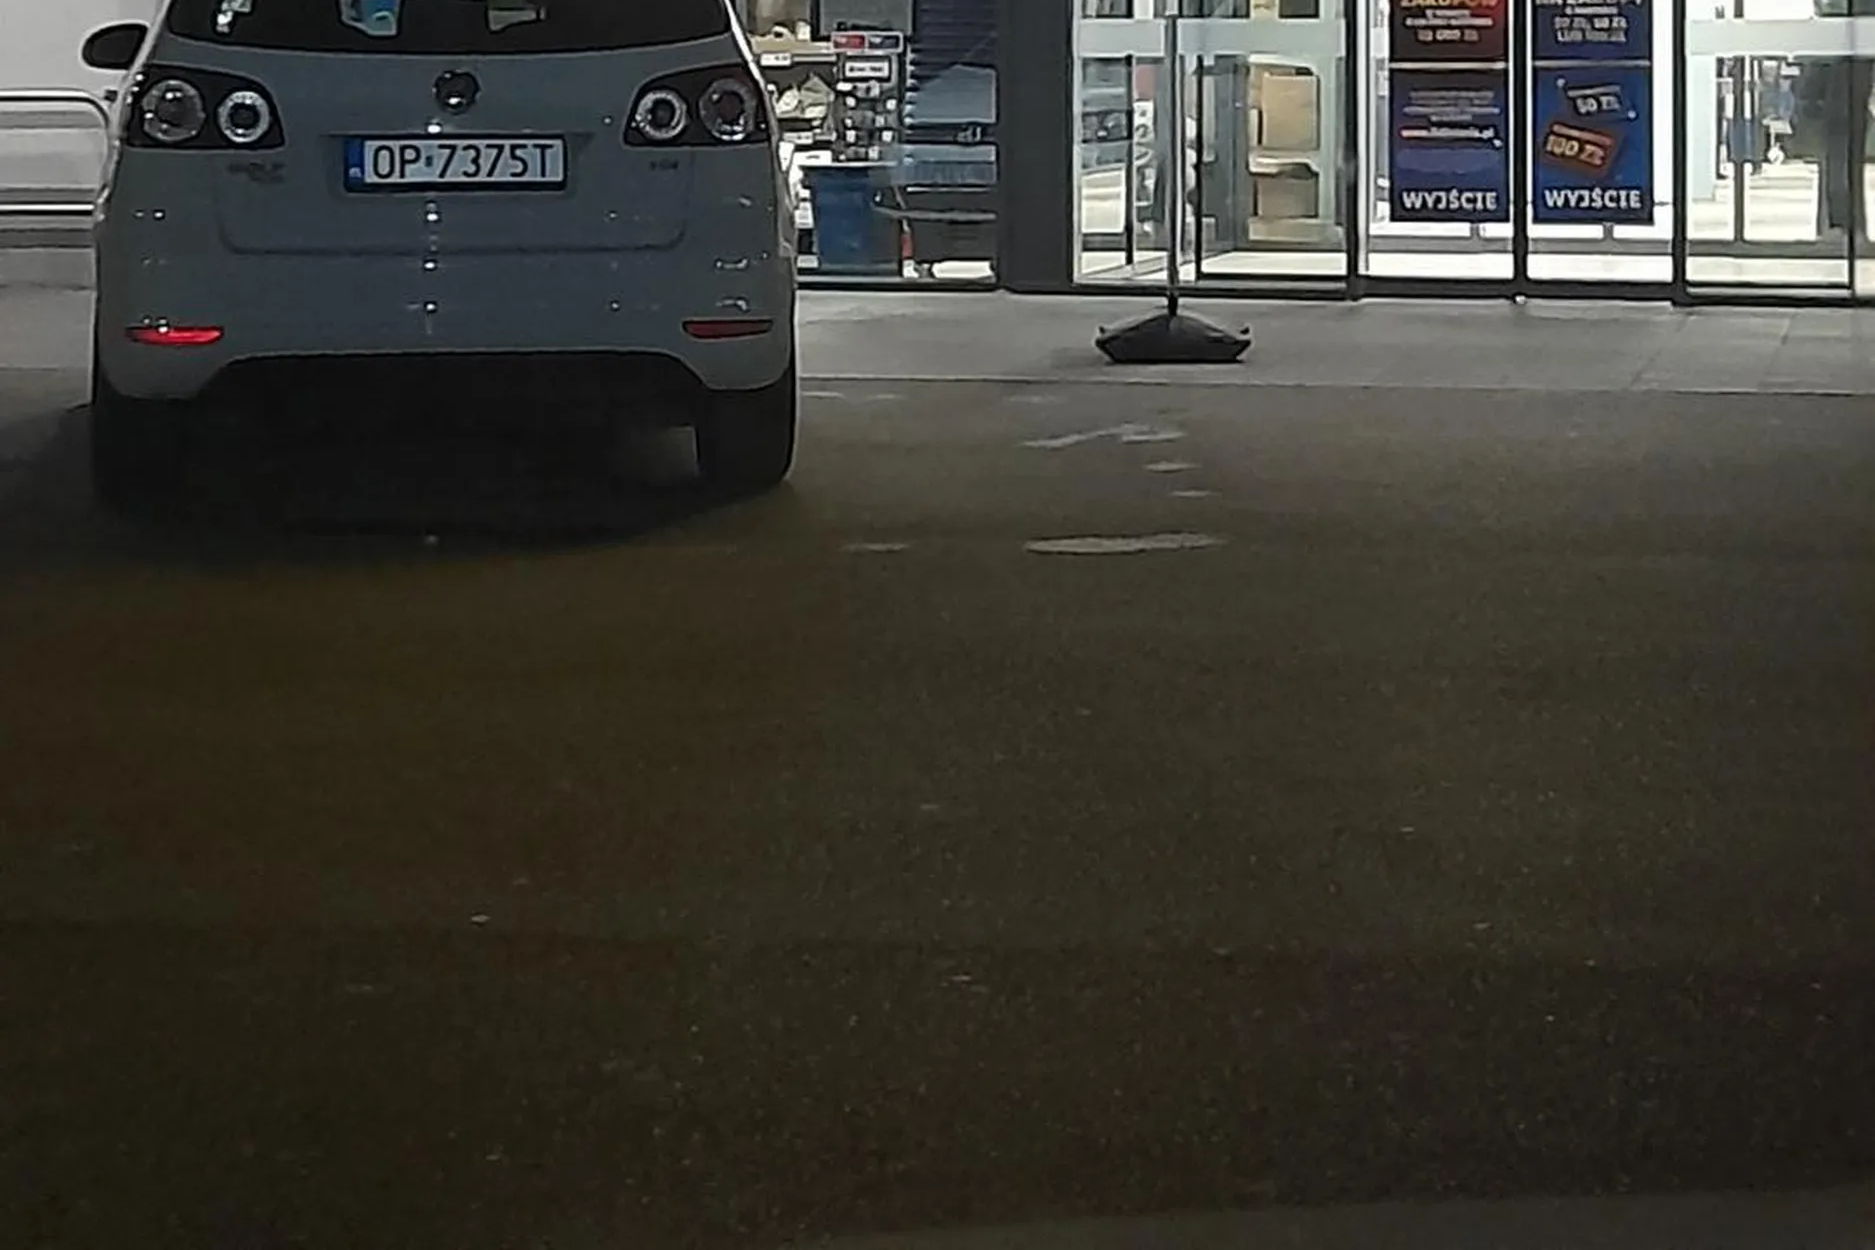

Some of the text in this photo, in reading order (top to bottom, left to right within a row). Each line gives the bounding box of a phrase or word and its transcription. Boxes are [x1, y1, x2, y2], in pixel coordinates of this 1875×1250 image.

[372, 143, 555, 179] OP 7375T
[1401, 188, 1498, 210] WYJŚCIE
[1543, 186, 1642, 210] WYJŚCIE
